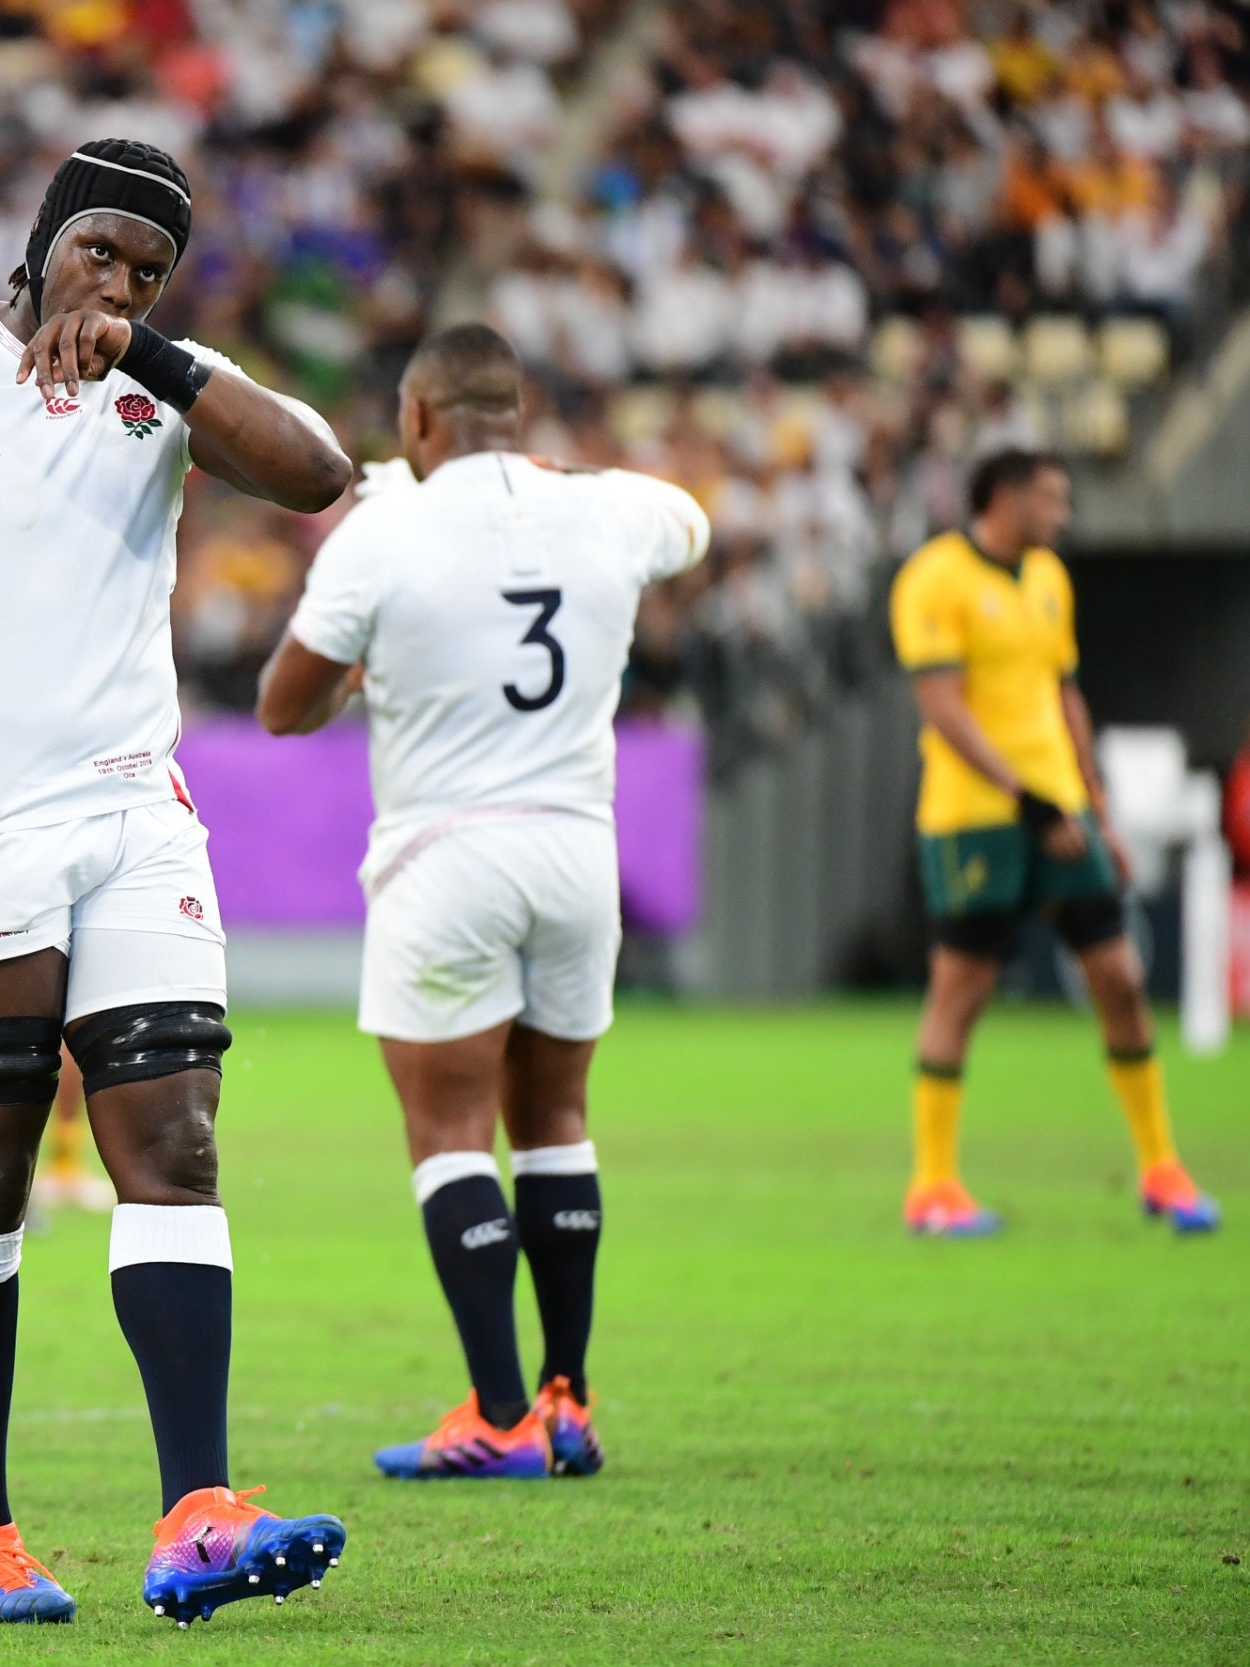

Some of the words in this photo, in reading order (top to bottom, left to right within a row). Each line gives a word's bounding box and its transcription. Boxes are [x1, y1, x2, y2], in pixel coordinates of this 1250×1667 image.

[499, 587, 565, 713] 3
[93, 756, 122, 767] England
[128, 751, 151, 760] Australia
[116, 763, 138, 771] October
